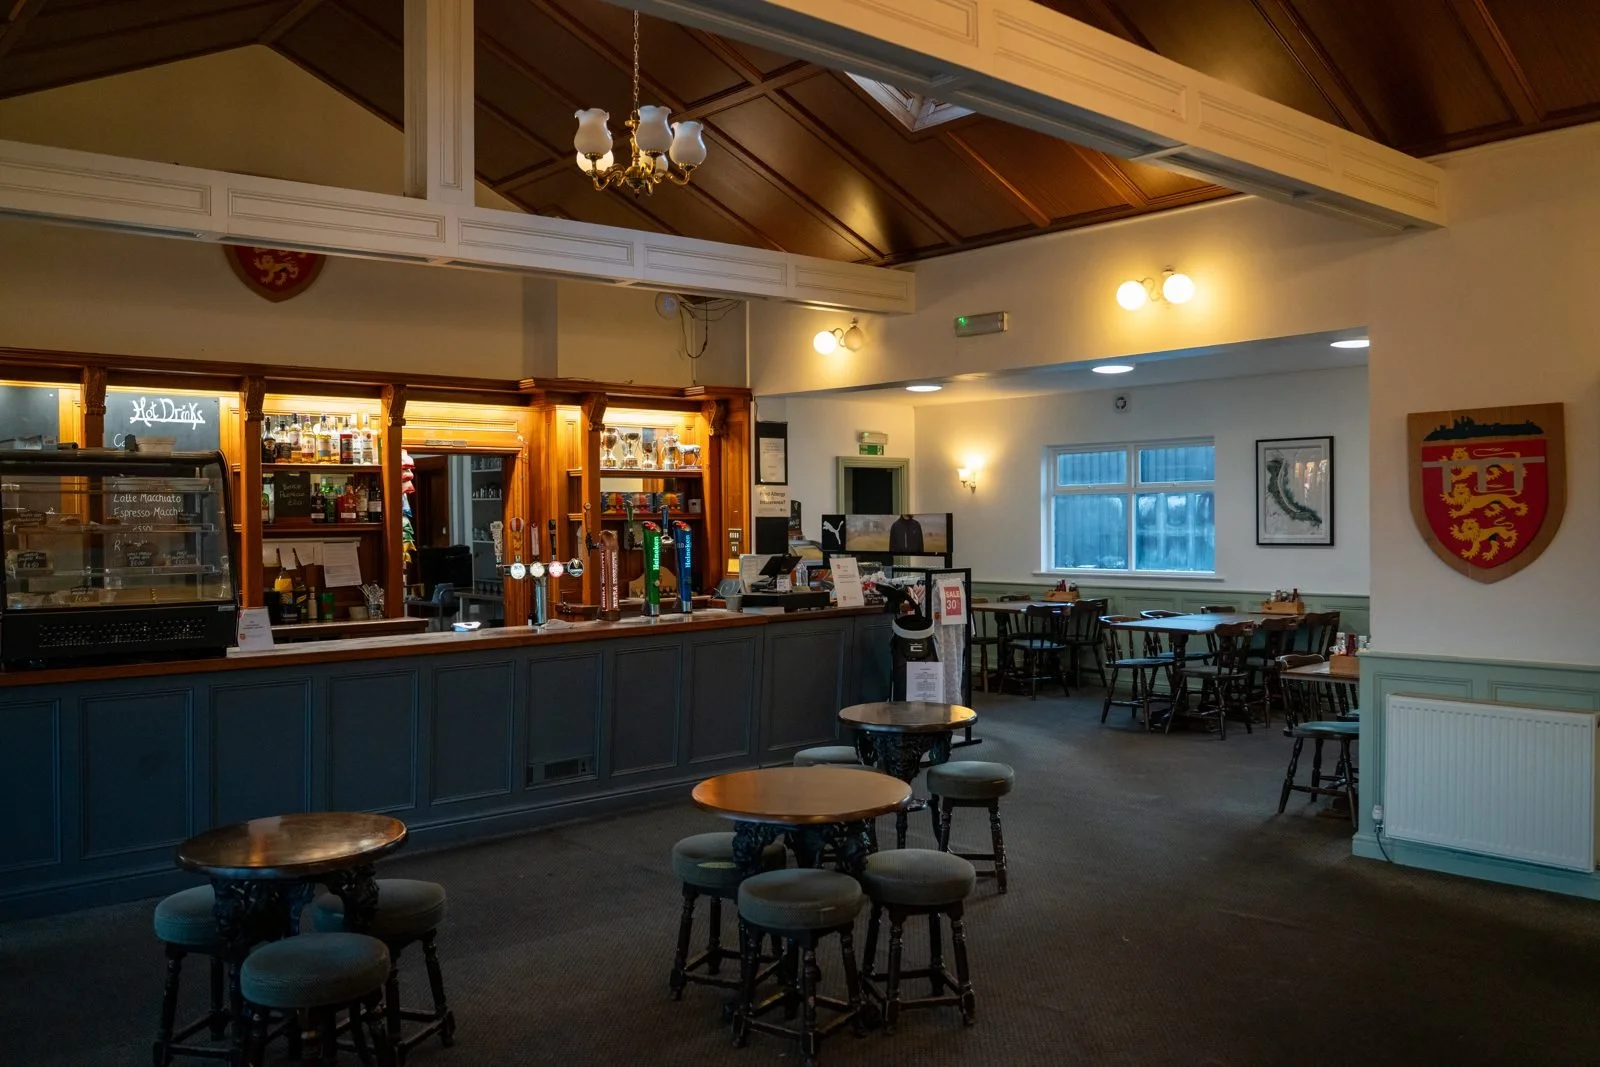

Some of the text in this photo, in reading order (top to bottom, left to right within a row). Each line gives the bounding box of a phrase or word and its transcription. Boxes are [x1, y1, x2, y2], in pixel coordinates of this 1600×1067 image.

[131, 397, 203, 430] Hot Drinks
[113, 493, 182, 504] Latte Macchiato
[113, 507, 150, 518] Espresso
[945, 590, 960, 598] SALE
[946, 599, 957, 610] 30
